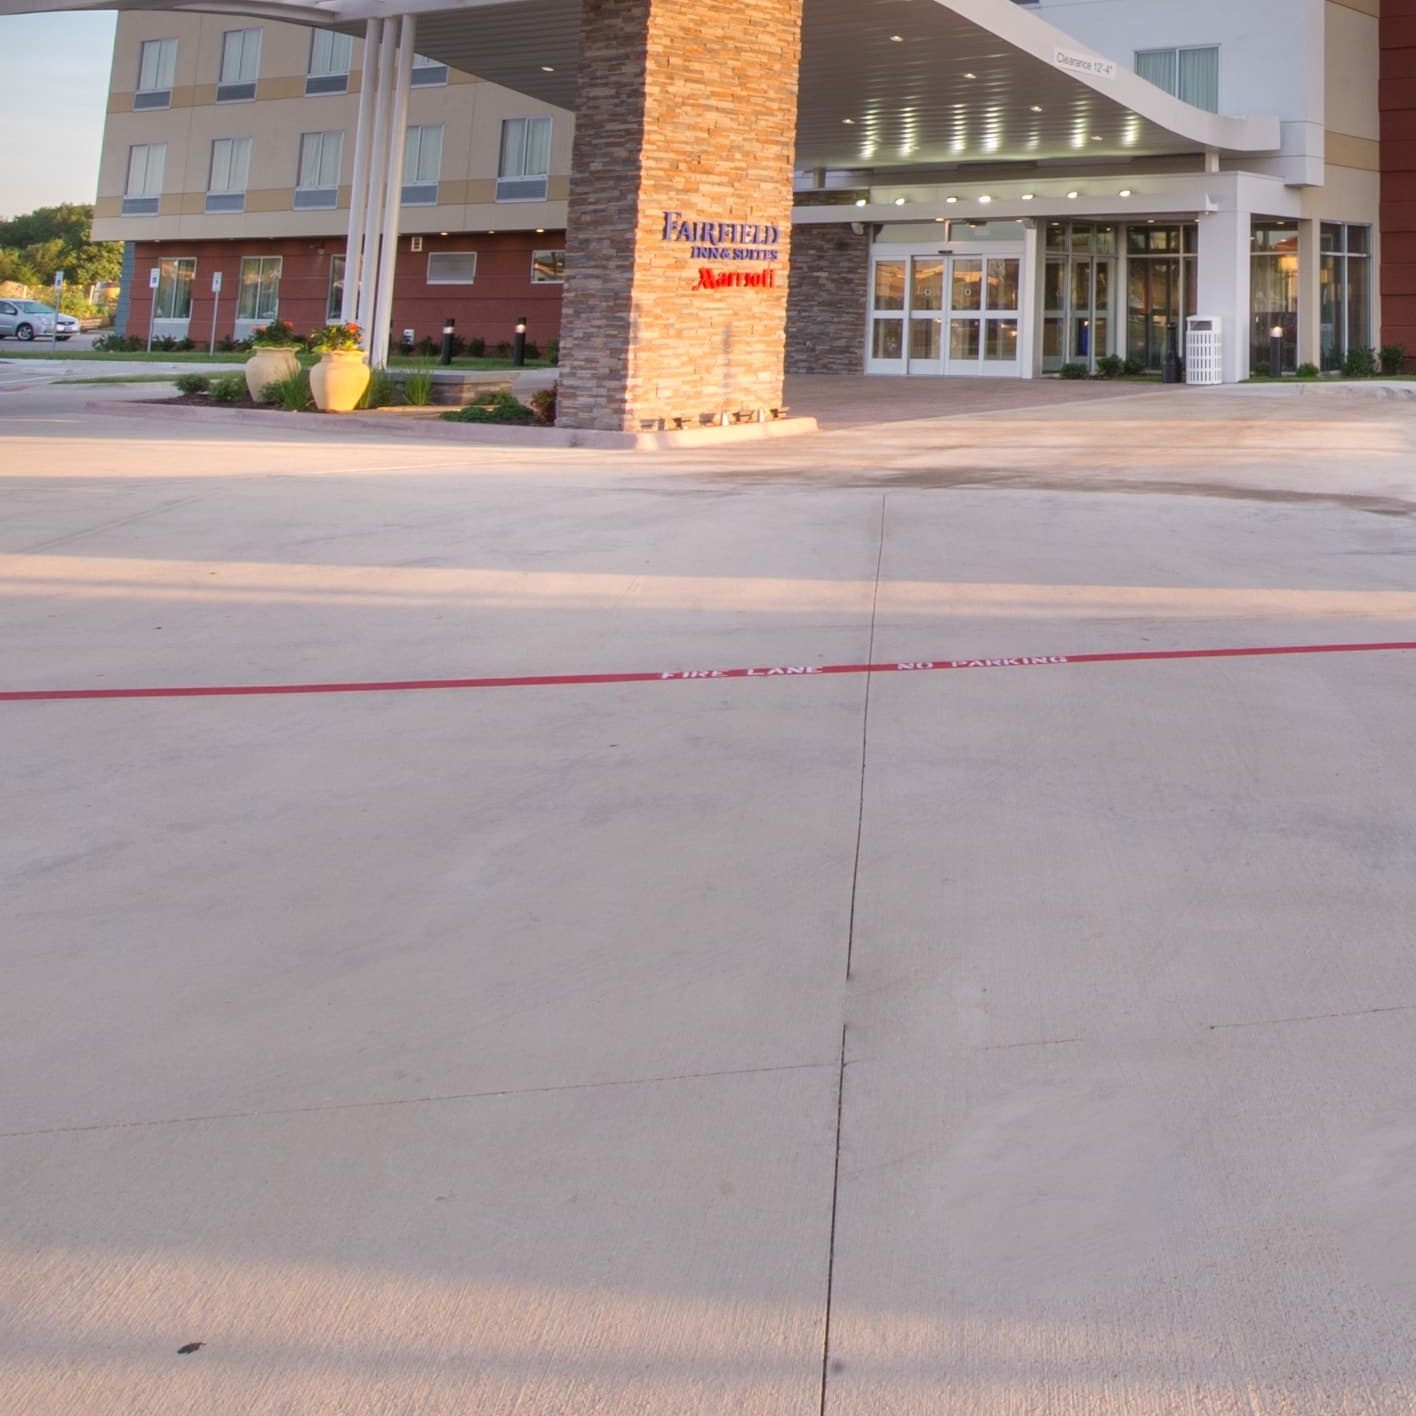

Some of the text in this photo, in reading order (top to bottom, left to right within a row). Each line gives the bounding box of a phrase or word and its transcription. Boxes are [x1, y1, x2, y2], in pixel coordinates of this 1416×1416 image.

[662, 211, 779, 245] FAIRFIELD
[690, 245, 778, 261] INN & SUITES
[691, 266, 775, 291] Marriott
[660, 655, 1068, 680] FIRE LANE NO PARKING
